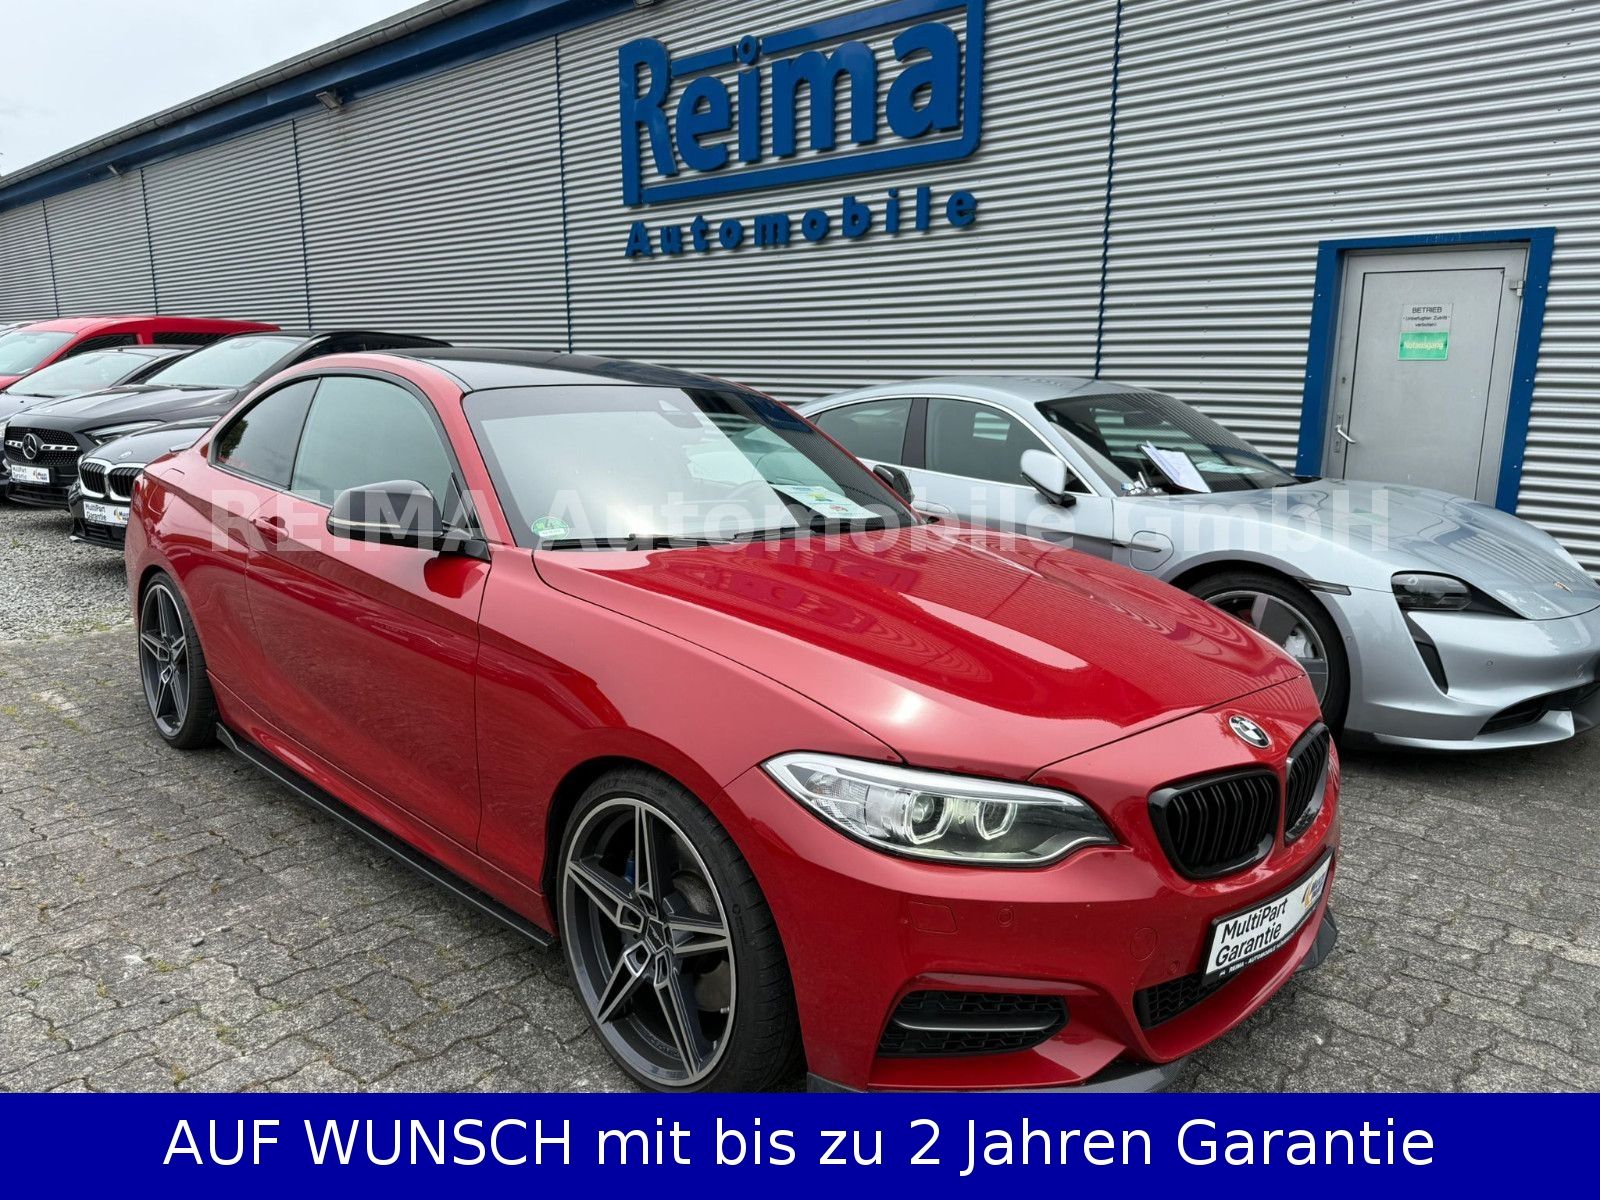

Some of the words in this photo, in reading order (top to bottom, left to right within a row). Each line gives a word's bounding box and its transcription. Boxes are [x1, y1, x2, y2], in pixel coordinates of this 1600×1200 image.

[618, 22, 961, 207] Reima
[625, 185, 977, 256] Automobile
[1215, 921, 1282, 967] Garantie
[1221, 898, 1288, 944] MultiPart
